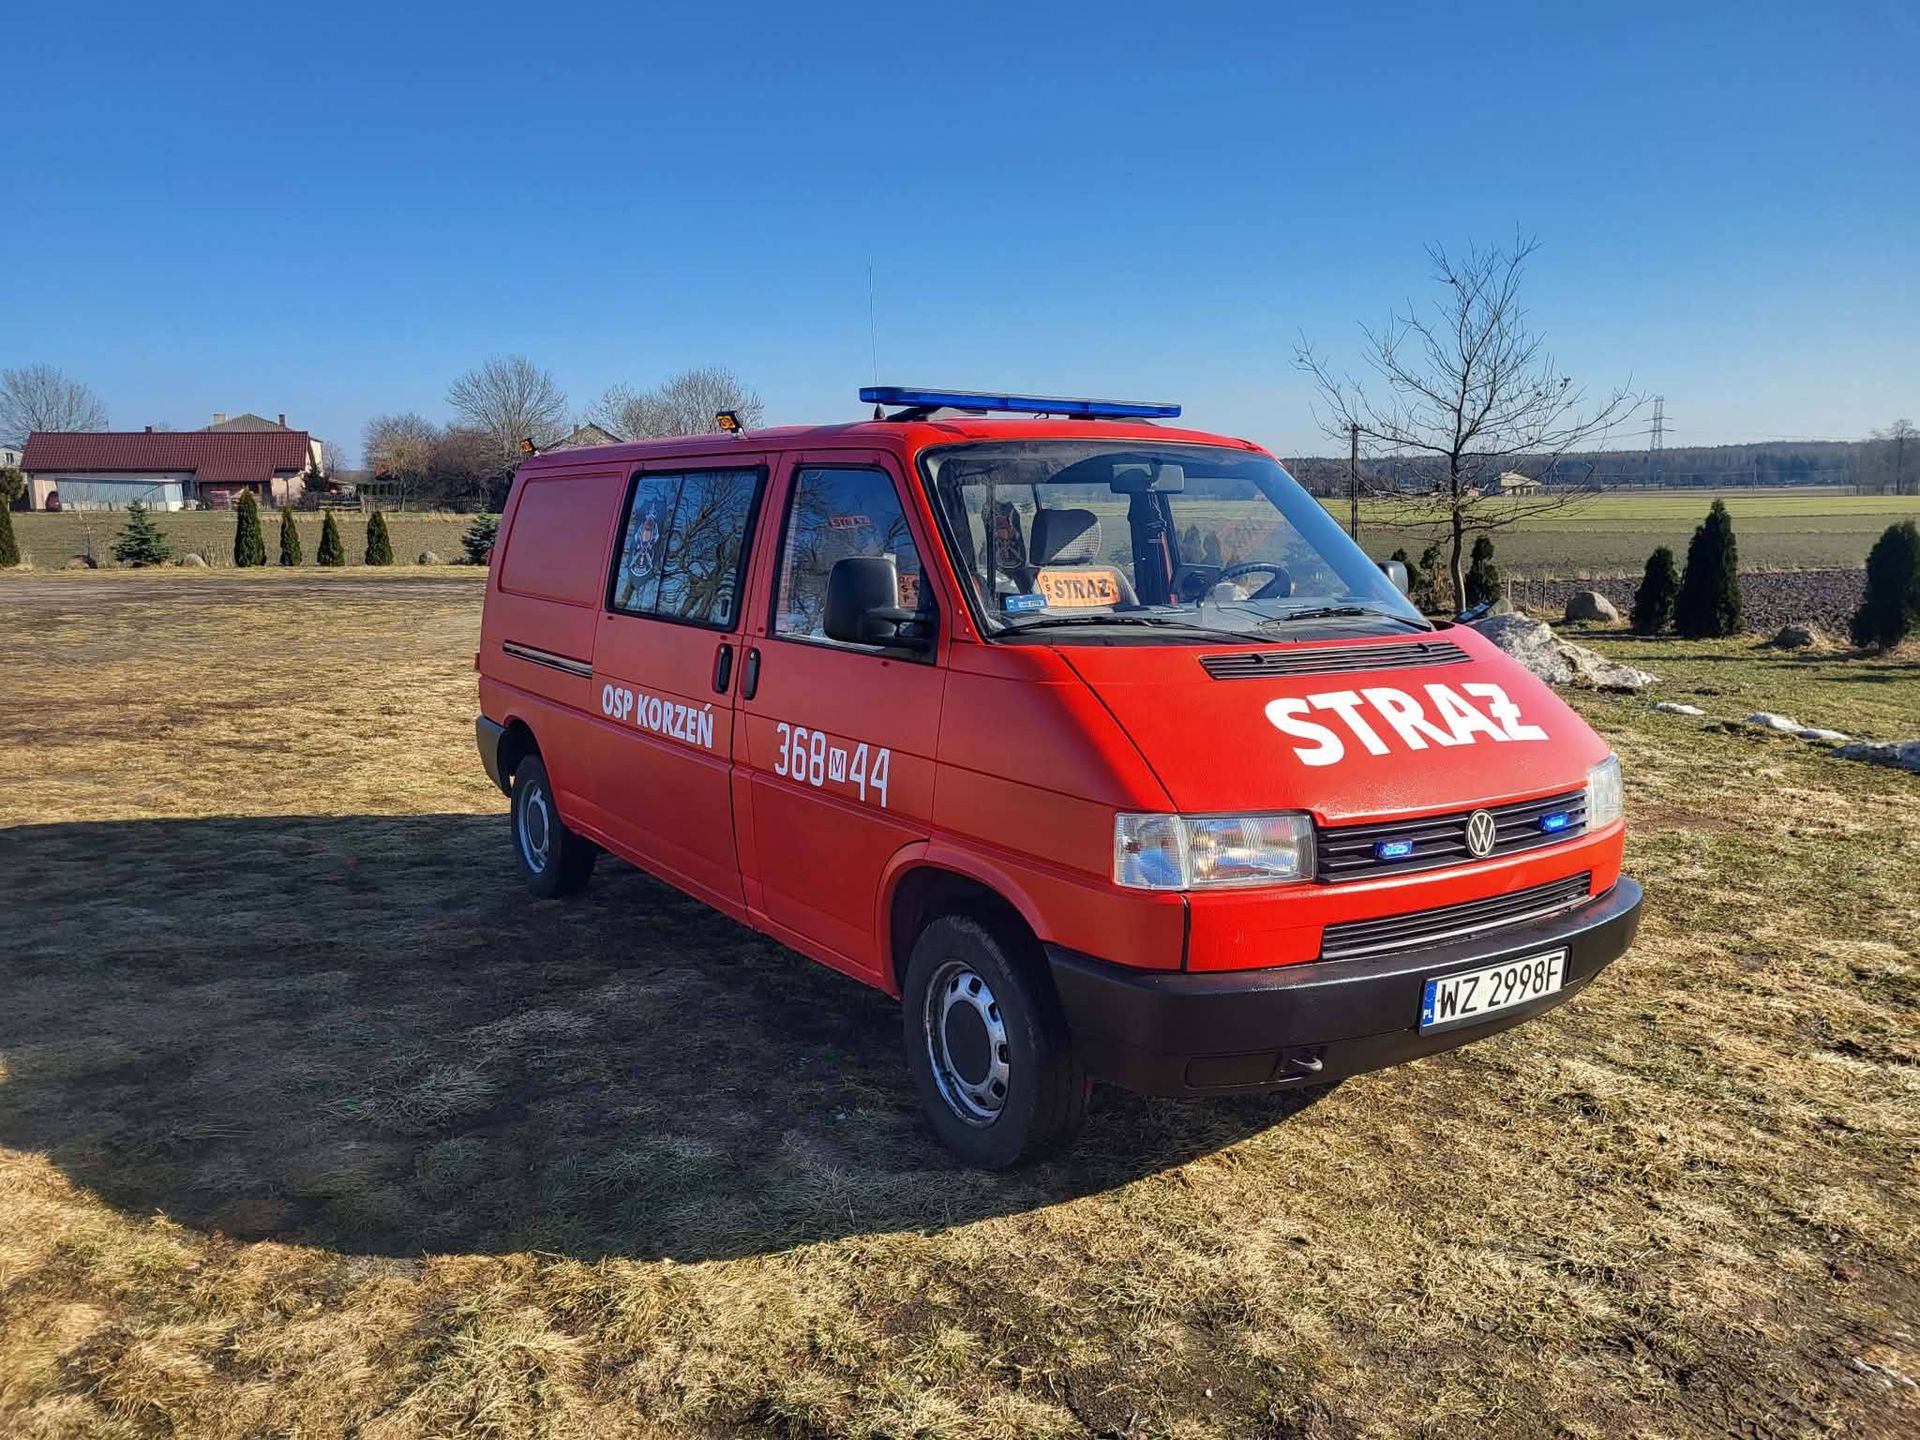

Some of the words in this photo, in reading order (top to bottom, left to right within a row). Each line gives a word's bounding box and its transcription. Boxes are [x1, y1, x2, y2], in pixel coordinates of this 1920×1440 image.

[602, 684, 633, 721] OSP
[637, 693, 714, 749] KORZEŃ
[1264, 682, 1550, 767] STRAŻ
[1423, 1009, 1433, 1020] PL
[1440, 976, 1480, 1019] WZ
[1487, 956, 1562, 1008] 2998F
